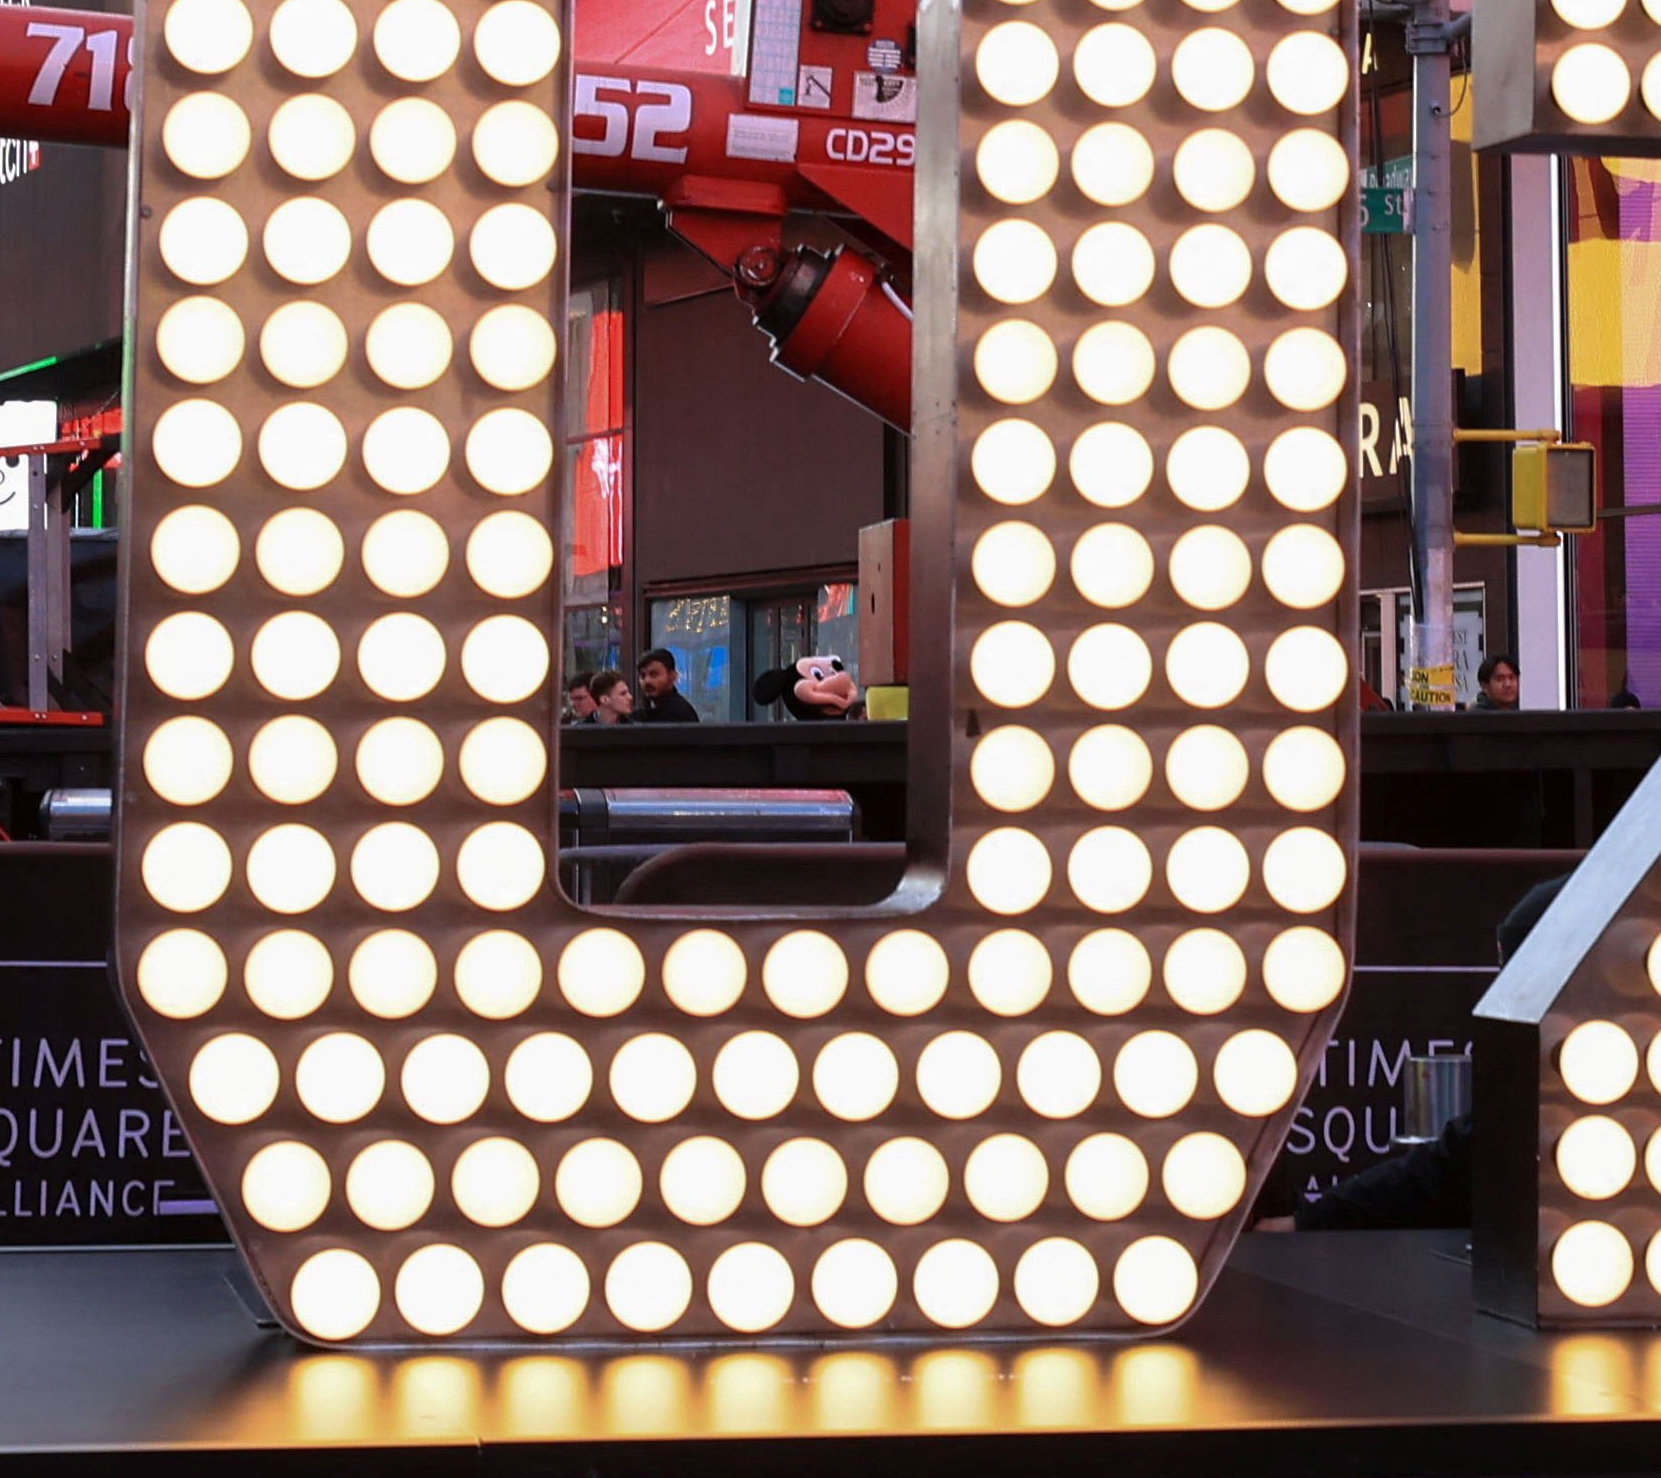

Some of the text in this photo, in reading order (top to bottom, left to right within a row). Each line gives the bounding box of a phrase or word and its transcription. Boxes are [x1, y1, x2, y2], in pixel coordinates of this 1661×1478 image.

[27, 22, 135, 112] 71
[1384, 192, 1404, 217] St
[1286, 1105, 1399, 1164] SQU
